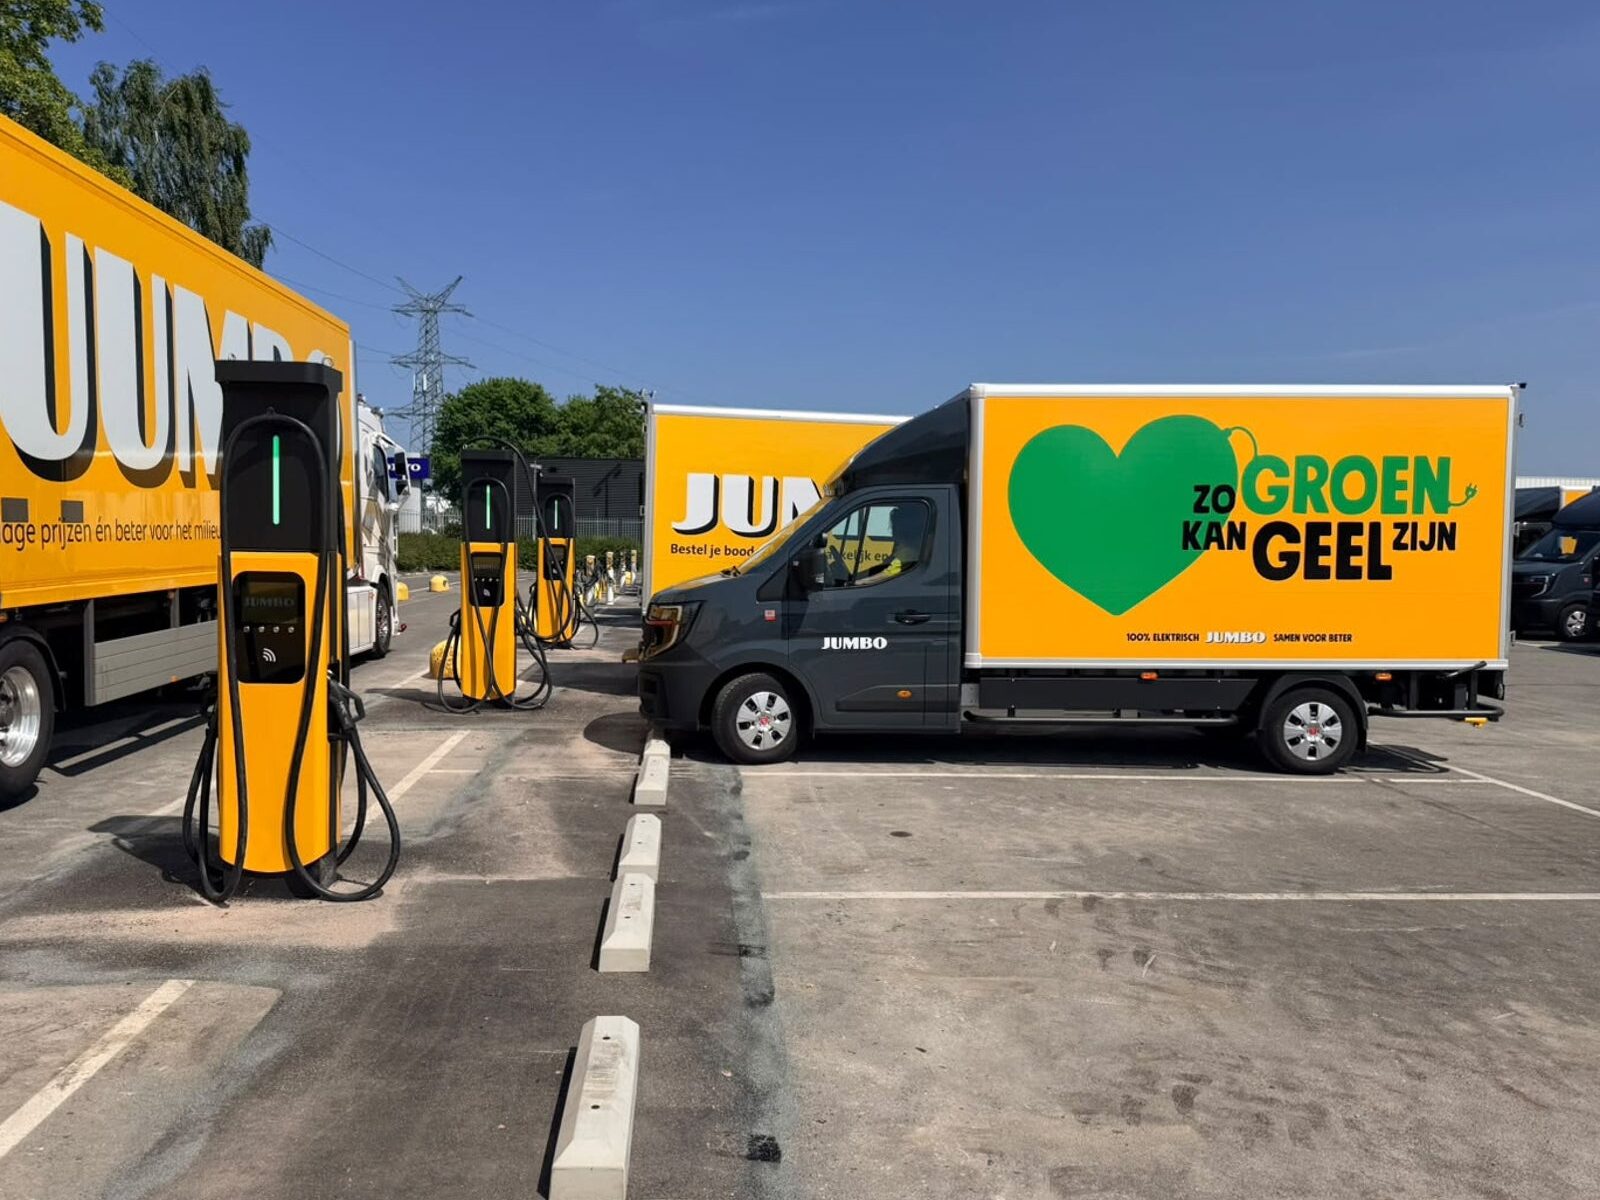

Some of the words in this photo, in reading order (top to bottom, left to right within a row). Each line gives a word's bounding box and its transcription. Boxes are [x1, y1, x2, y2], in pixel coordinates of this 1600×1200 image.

[0, 201, 343, 487] UUM
[1193, 484, 1236, 514] ZO
[1242, 454, 1451, 515] GROEN
[0, 523, 36, 551] age
[41, 517, 91, 550] prijzen
[96, 516, 111, 541] én
[115, 519, 147, 541] beter
[150, 524, 173, 540] voor
[175, 519, 193, 540] het
[671, 543, 707, 555] Bestel
[709, 544, 721, 558] je
[1182, 521, 1247, 551] KAN
[1252, 521, 1392, 581] GEEL
[1392, 522, 1457, 551] ZIJN
[821, 636, 888, 650] JUMBO
[1126, 633, 1150, 642] 100%
[1153, 633, 1199, 642] ELEKTRISCH
[1205, 631, 1267, 643] JUMBO
[1273, 633, 1300, 642] SAMEN
[1302, 633, 1326, 642] VOOR
[1329, 633, 1352, 642] BETER
